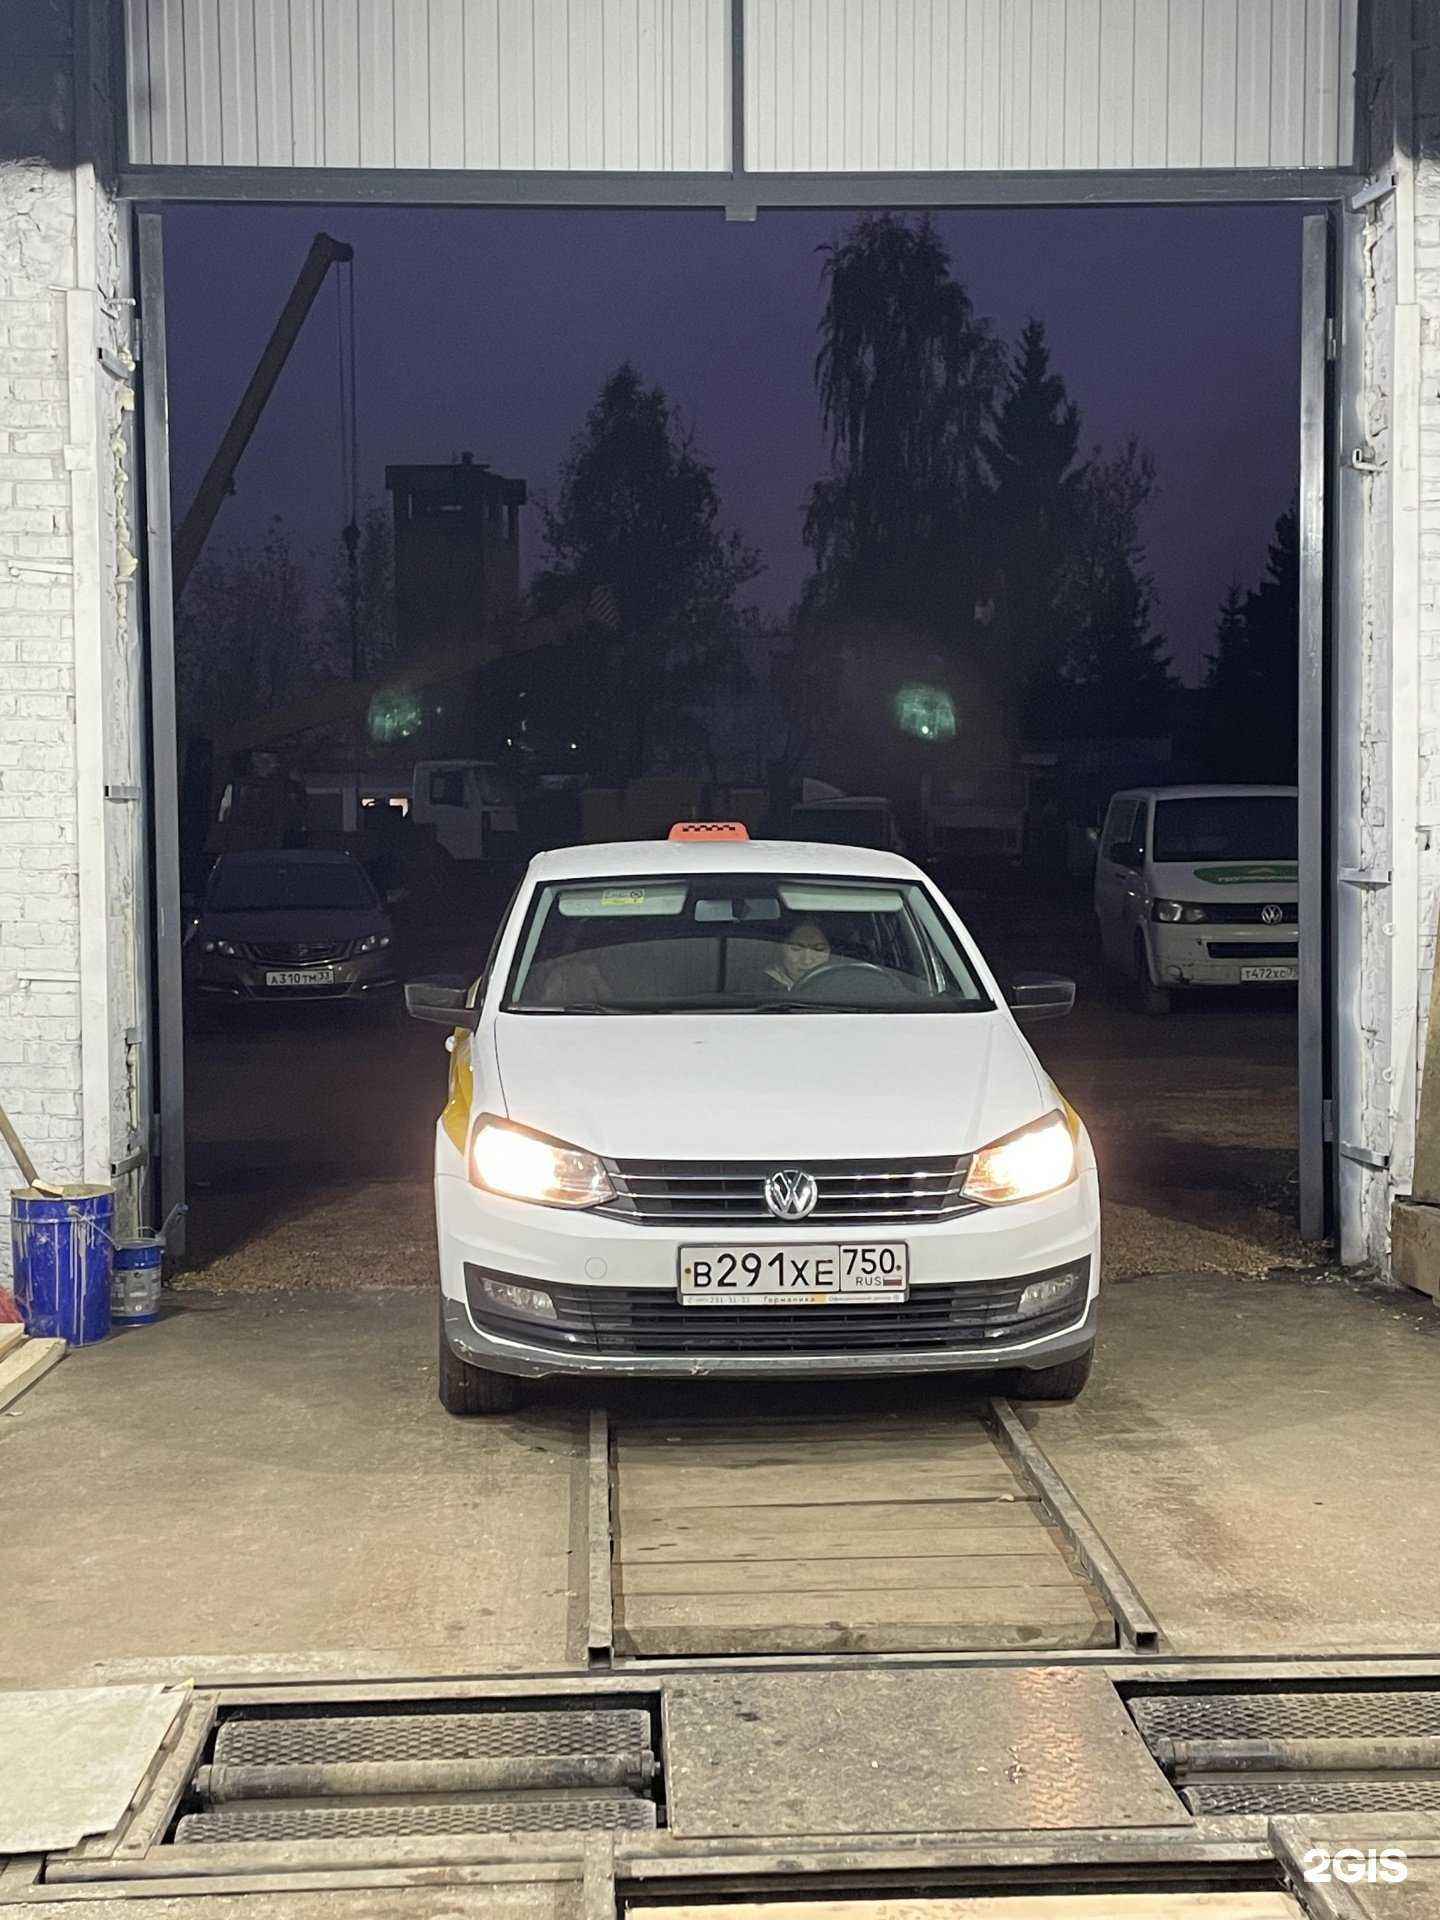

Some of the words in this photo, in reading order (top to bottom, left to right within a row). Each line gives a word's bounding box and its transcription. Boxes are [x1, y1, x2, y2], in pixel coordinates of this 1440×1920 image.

[693, 1252, 834, 1287] В291ХЕ
[842, 1248, 895, 1275] 750
[855, 1276, 882, 1287] RUS
